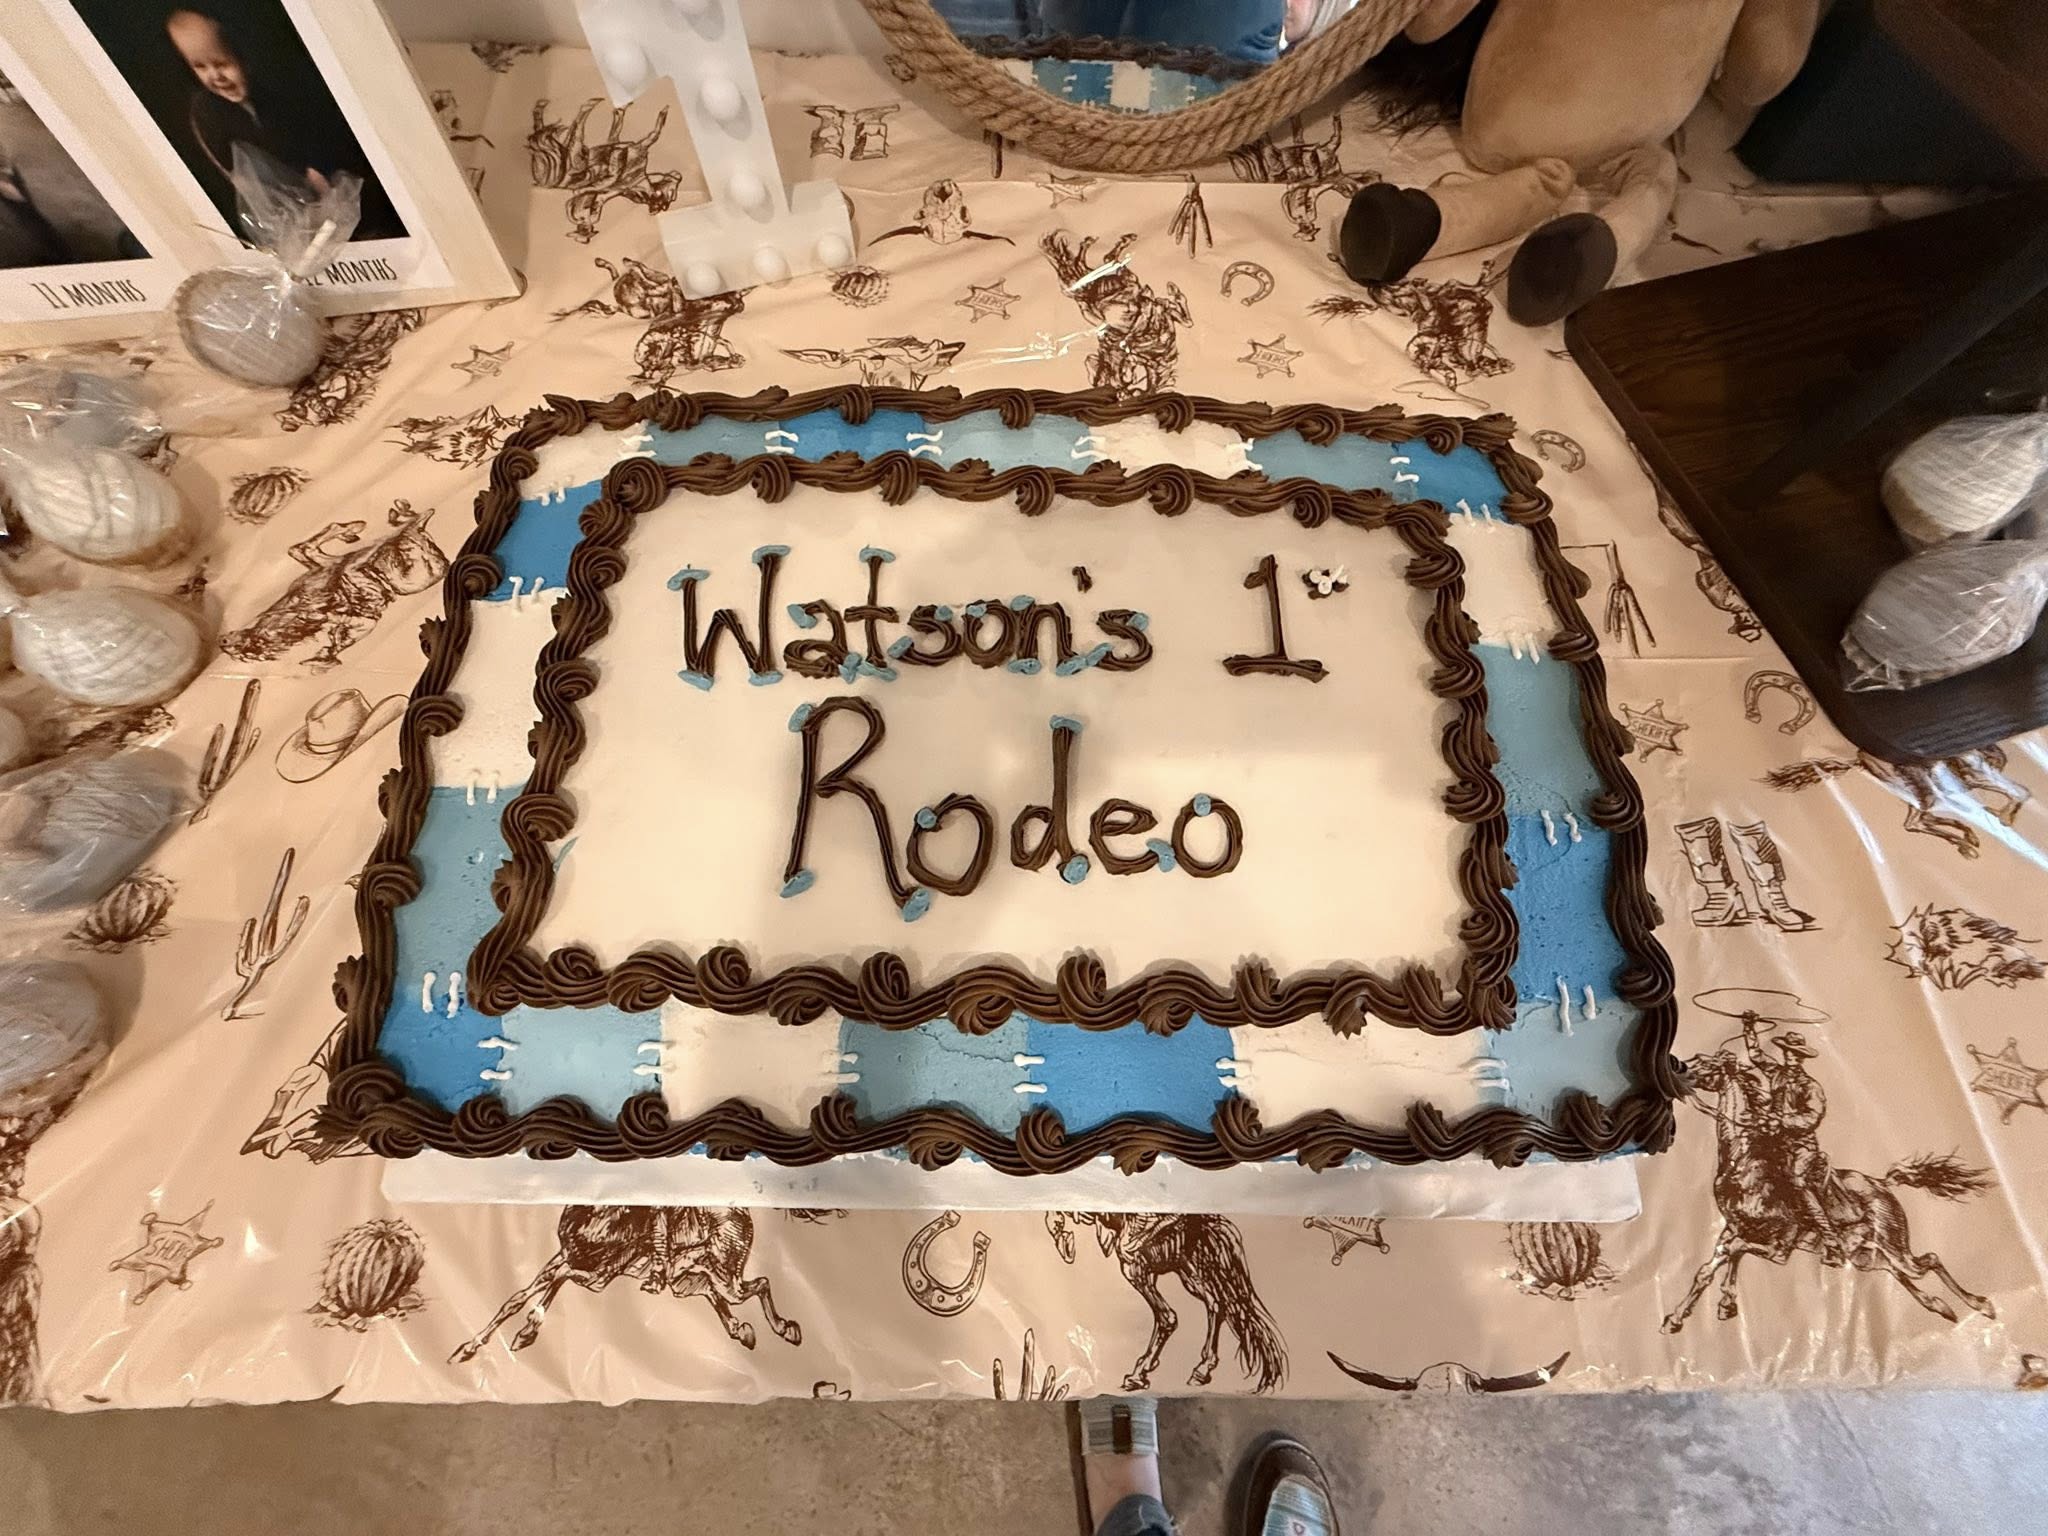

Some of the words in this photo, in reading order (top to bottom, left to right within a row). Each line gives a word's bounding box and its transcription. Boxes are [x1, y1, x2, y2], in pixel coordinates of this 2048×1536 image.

[31, 282, 70, 309] 11
[61, 279, 147, 308] MONTHS
[325, 258, 398, 285] MONTHS
[667, 545, 1153, 690] Watson's
[780, 696, 1244, 922] Rodeo
